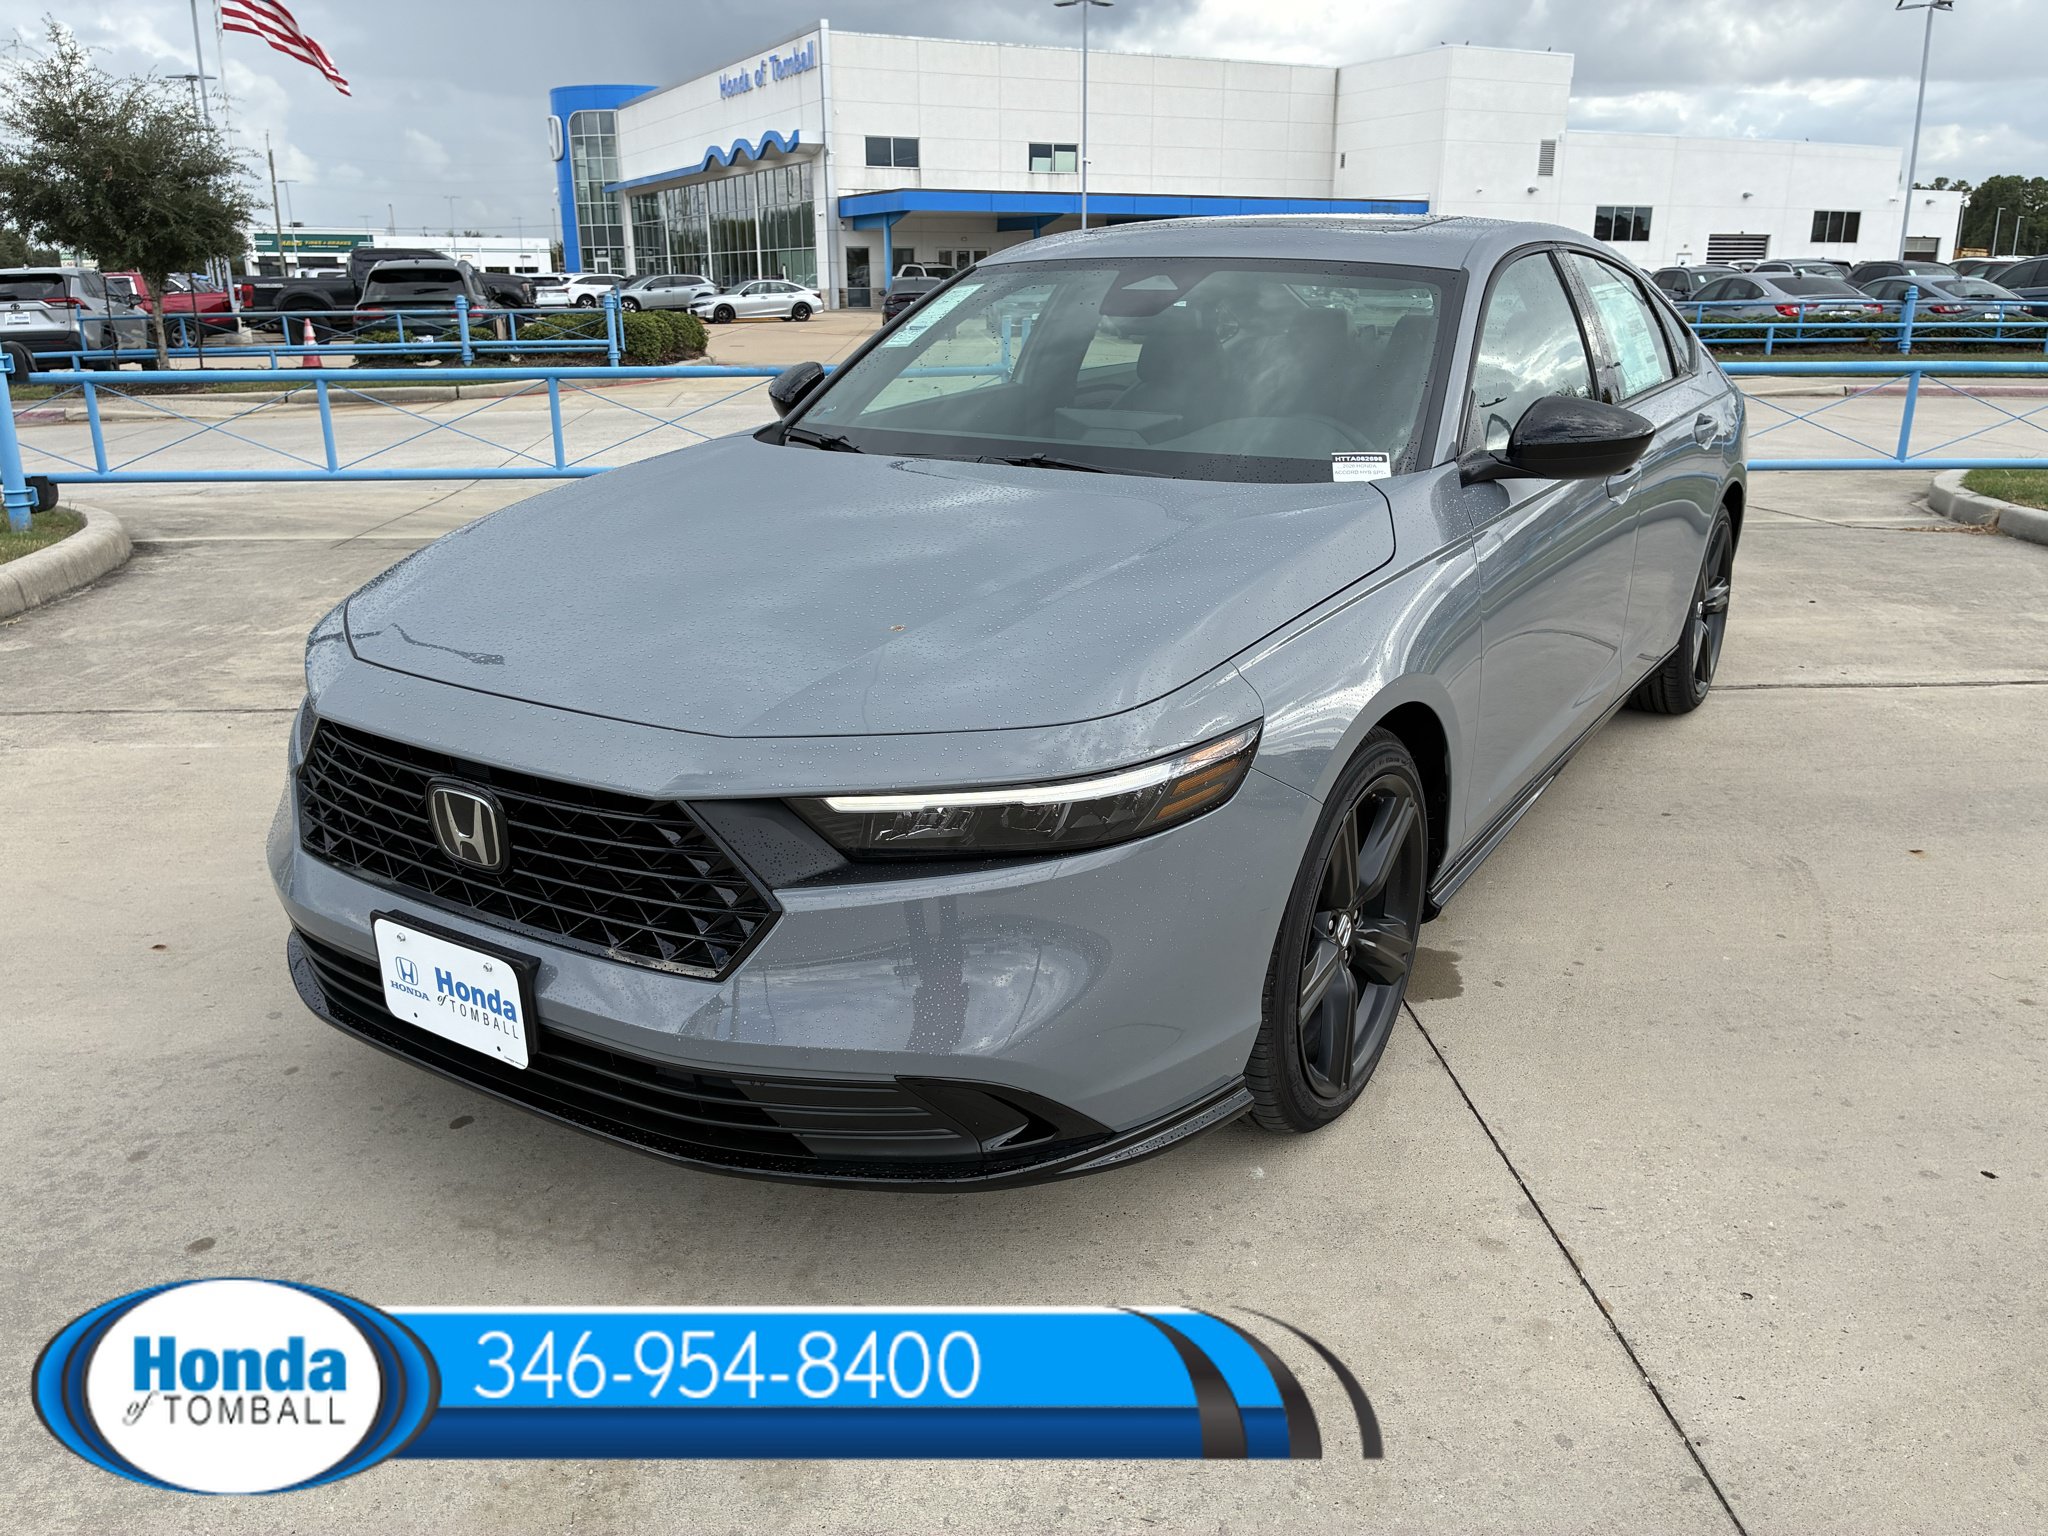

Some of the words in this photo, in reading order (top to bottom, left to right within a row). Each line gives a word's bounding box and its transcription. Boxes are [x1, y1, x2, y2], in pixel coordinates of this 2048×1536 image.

[719, 67, 753, 99] Honda
[754, 59, 767, 87] of
[769, 40, 817, 82] Tomball
[390, 980, 430, 1001] HONDA
[434, 966, 518, 1023] Honda
[437, 994, 448, 1007] of
[450, 999, 519, 1039] TOMBALL
